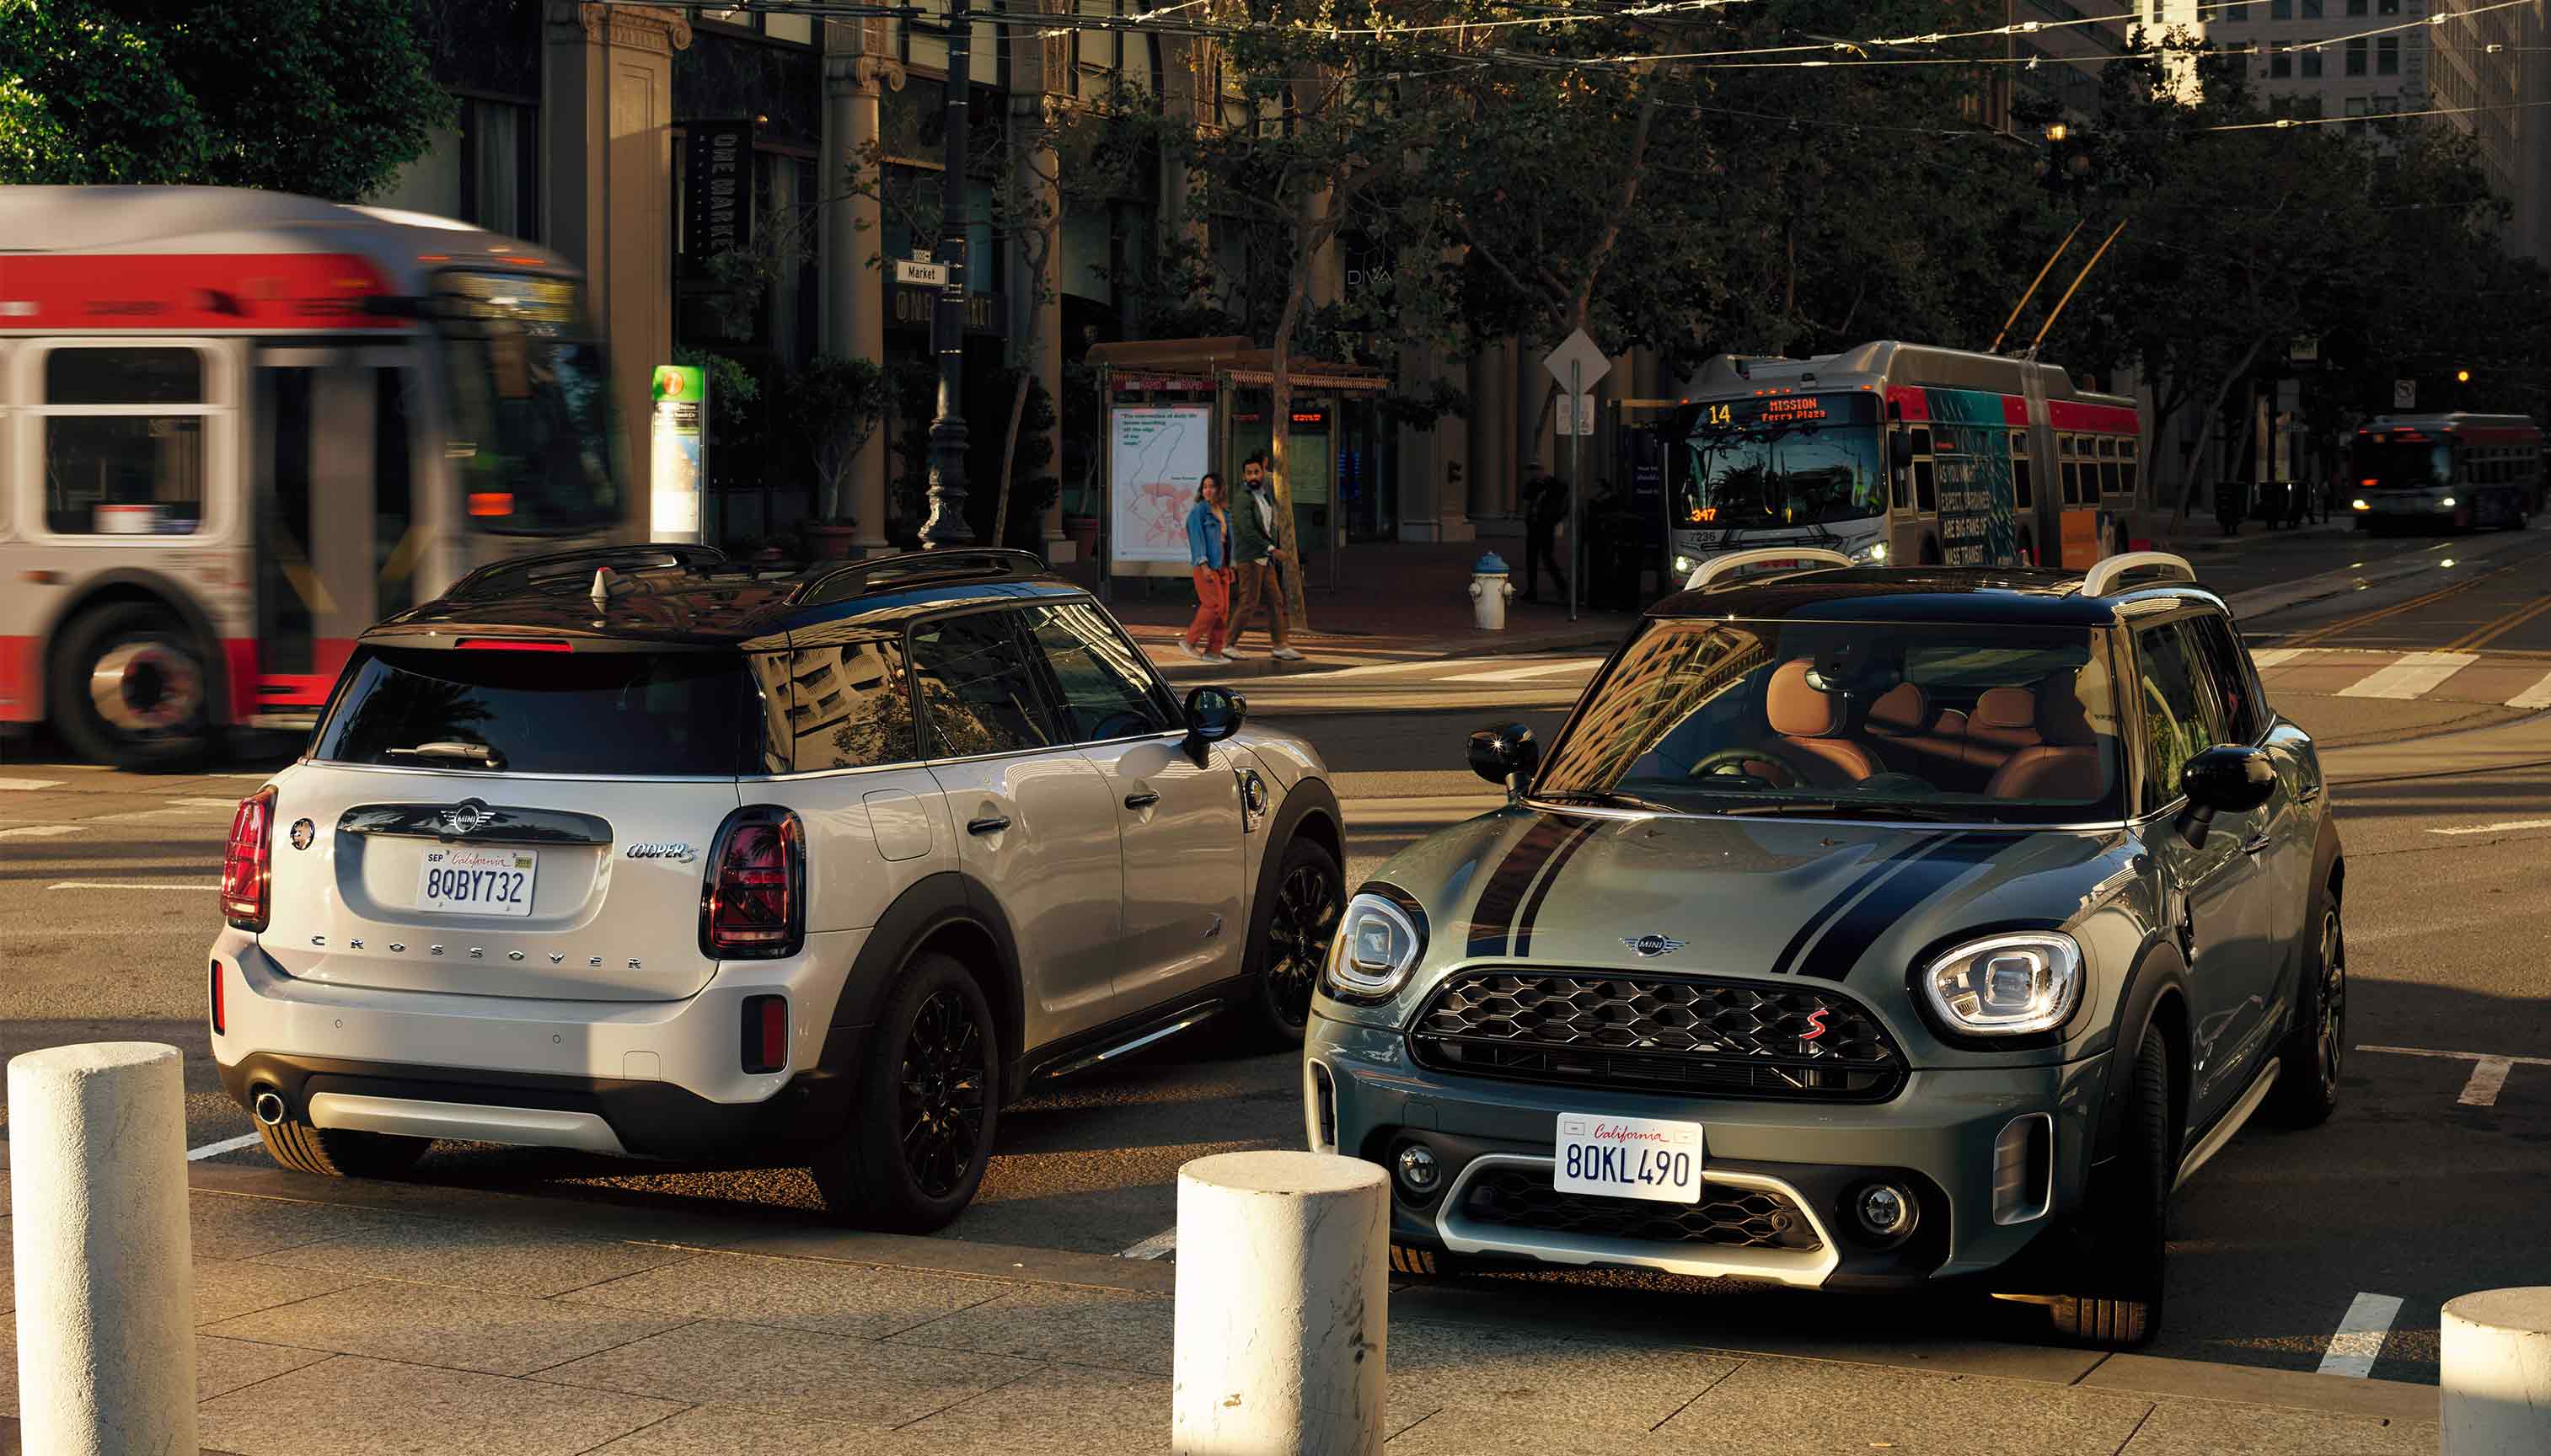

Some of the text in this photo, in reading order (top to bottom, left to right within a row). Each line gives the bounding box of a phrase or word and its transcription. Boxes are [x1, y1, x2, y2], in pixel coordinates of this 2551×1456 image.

[710, 134, 737, 175] ONE
[908, 266, 935, 280] Market
[1709, 404, 1731, 424] 14
[1770, 398, 1817, 411] MISSION
[1761, 410, 1826, 422] Ferry Plaza
[1691, 509, 1717, 522] 347
[1945, 546, 1960, 566] MASS
[1961, 545, 1982, 565] TRANSIT
[427, 854, 444, 863] SEP
[452, 850, 513, 869] California
[626, 843, 686, 858] COOPER
[427, 868, 524, 903] 8QBY732
[311, 934, 642, 972] CROSSOVER
[1639, 940, 1664, 949] MINI
[1798, 1010, 1830, 1040] S
[1594, 1123, 1669, 1143] California
